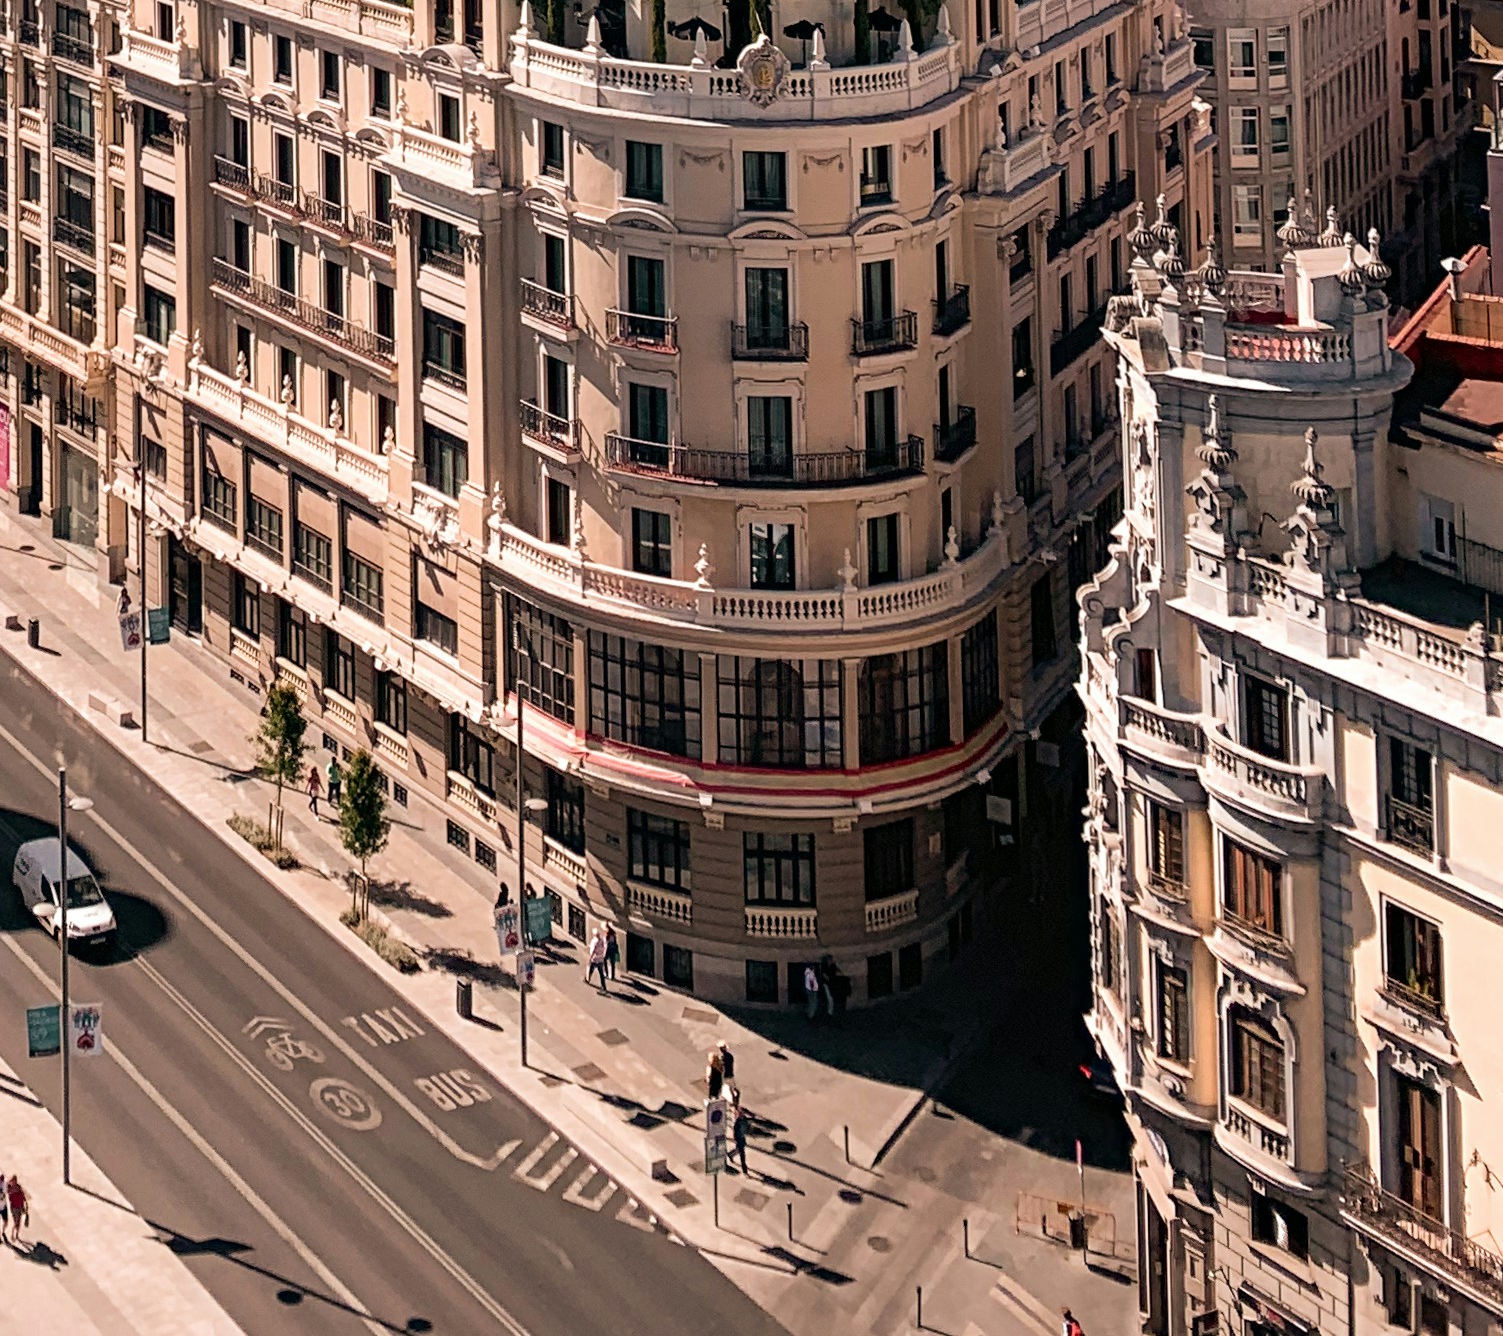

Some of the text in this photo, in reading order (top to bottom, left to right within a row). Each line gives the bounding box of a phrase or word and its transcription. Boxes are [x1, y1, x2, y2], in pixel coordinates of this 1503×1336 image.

[340, 1006, 426, 1047] TAXI
[323, 1089, 366, 1117] 30
[413, 1069, 493, 1111] BUS
